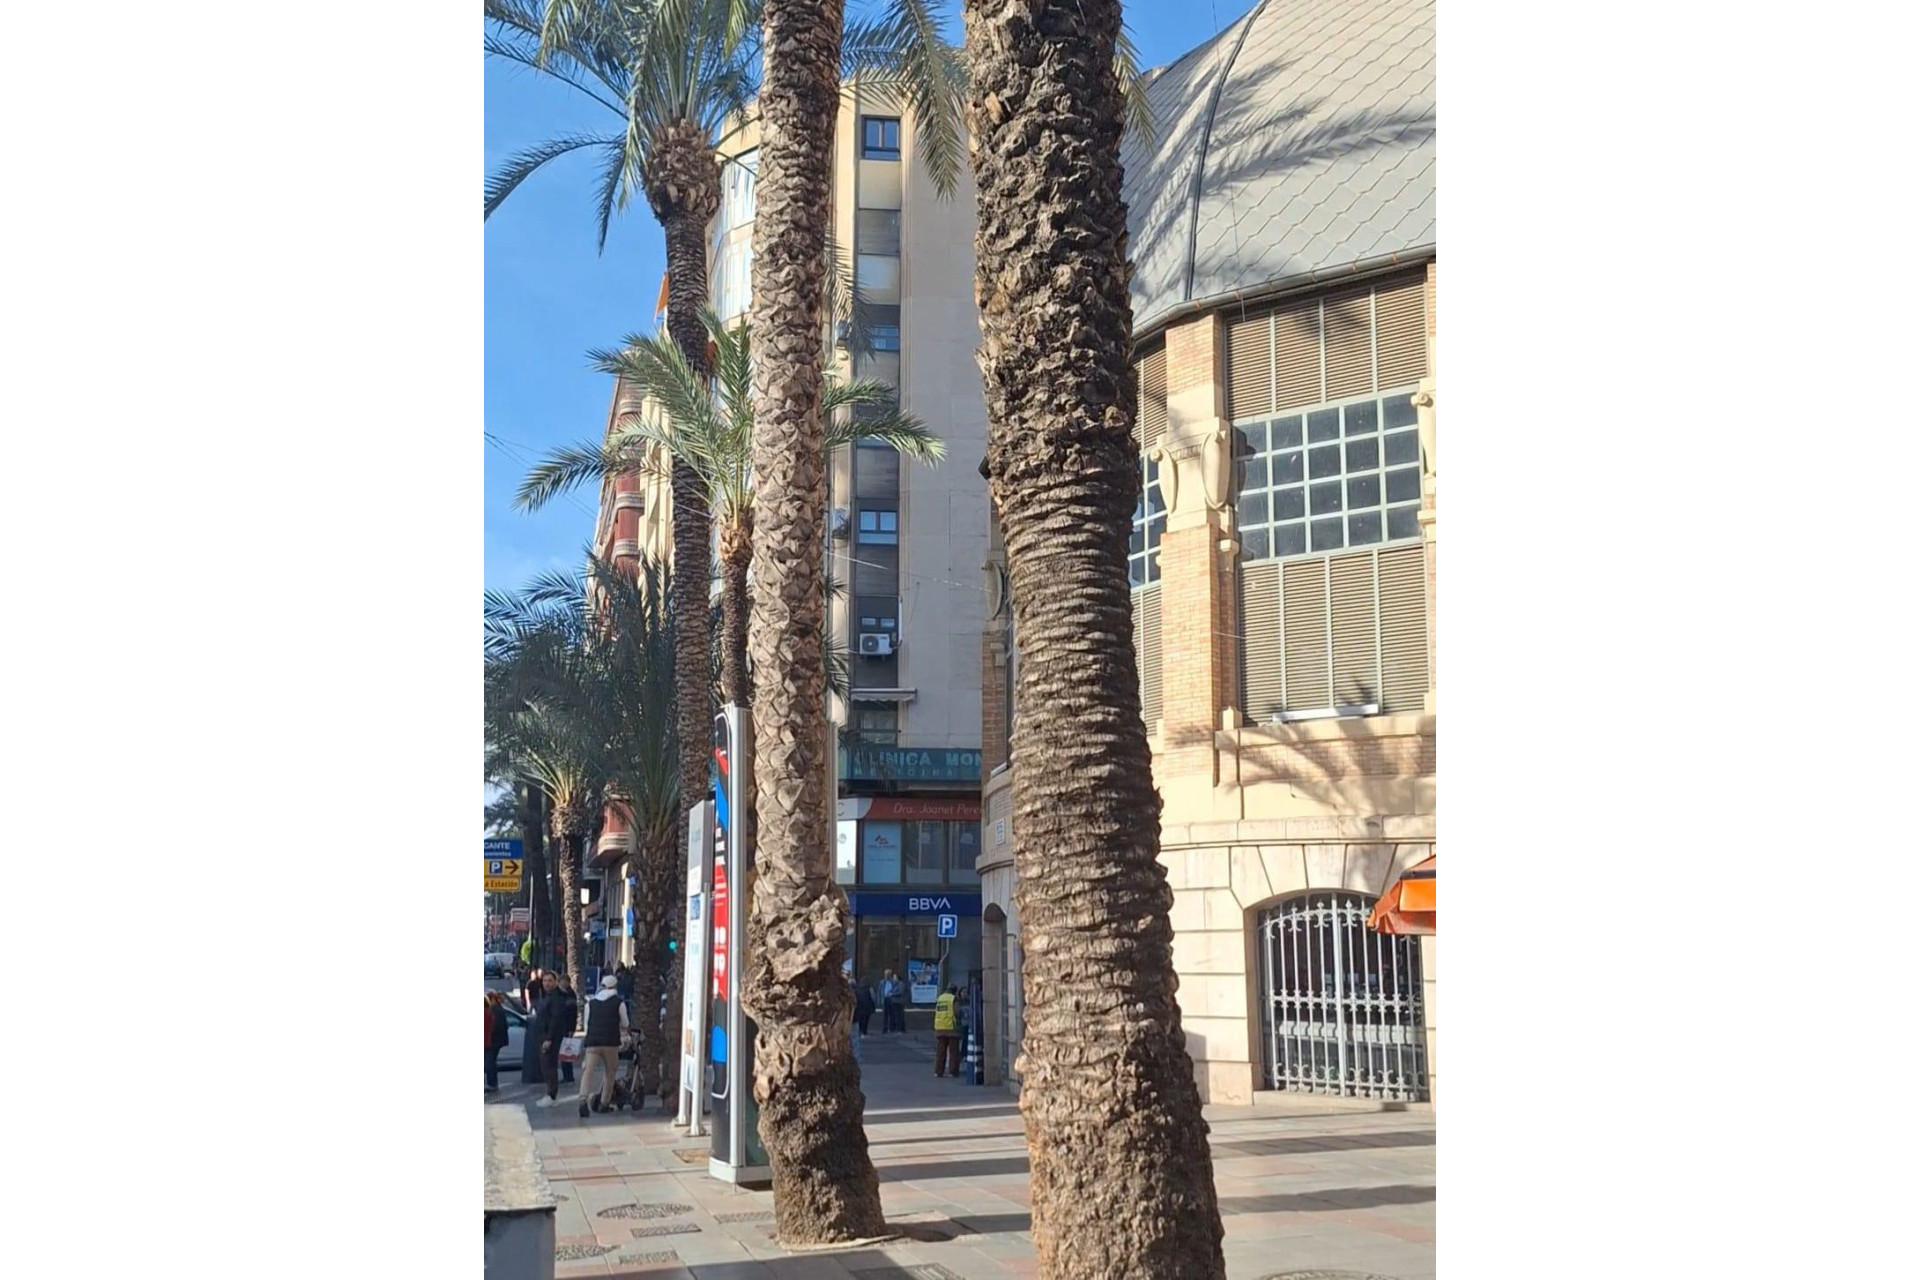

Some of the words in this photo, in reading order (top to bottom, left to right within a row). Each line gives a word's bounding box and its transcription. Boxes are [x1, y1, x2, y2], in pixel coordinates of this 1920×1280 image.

[853, 751, 932, 766] LINICA
[854, 768, 954, 777] MEICINA
[893, 803, 917, 815] Dra.
[490, 861, 502, 873] P
[909, 898, 951, 911] BBVA
[941, 917, 953, 934] P
